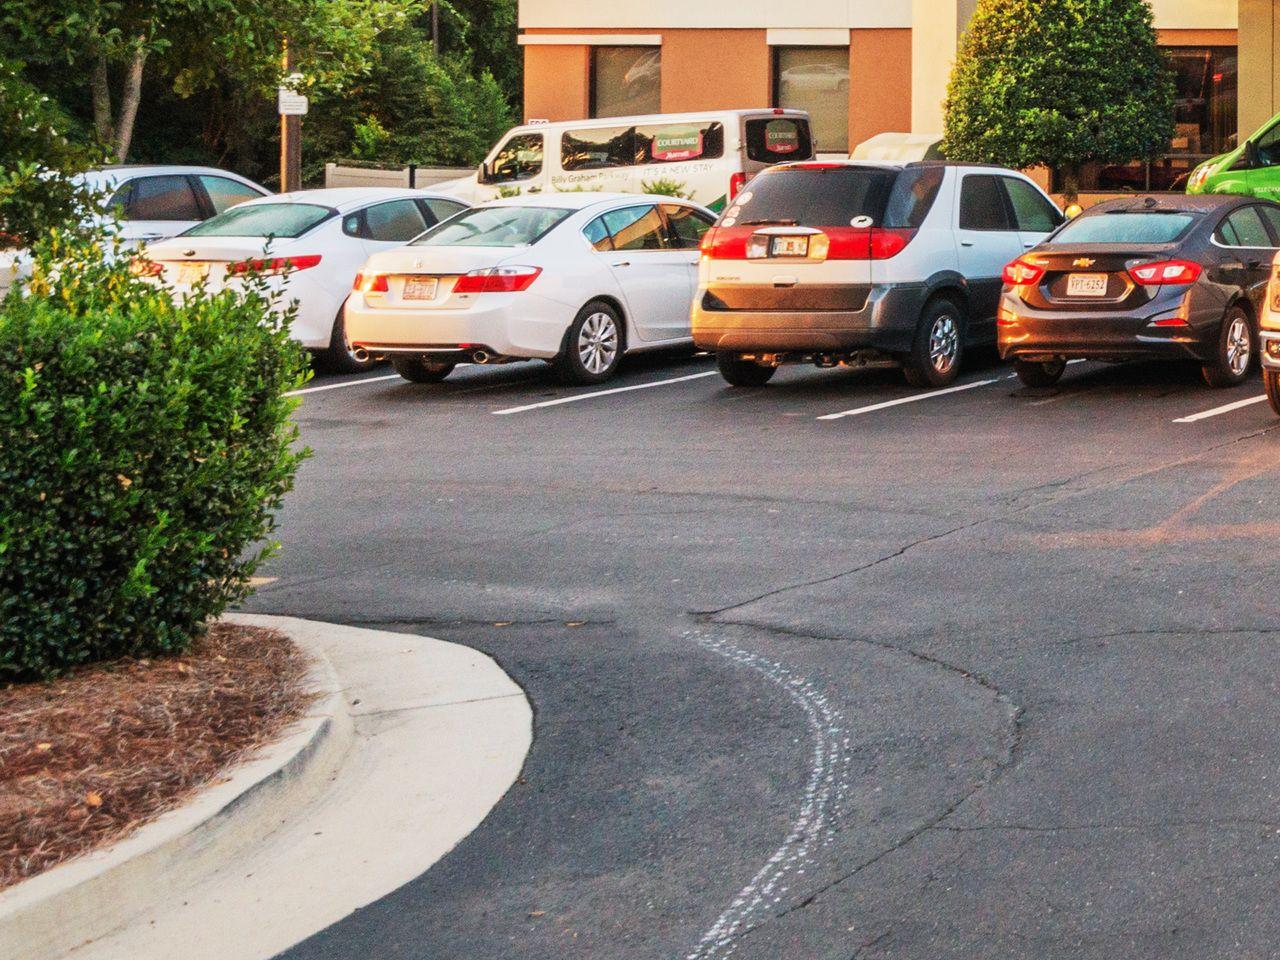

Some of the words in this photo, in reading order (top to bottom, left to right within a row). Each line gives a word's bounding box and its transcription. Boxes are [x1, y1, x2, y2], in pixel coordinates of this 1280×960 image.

[657, 138, 699, 146] COURTYARD
[693, 164, 713, 172] STAY
[568, 174, 598, 183] Graham
